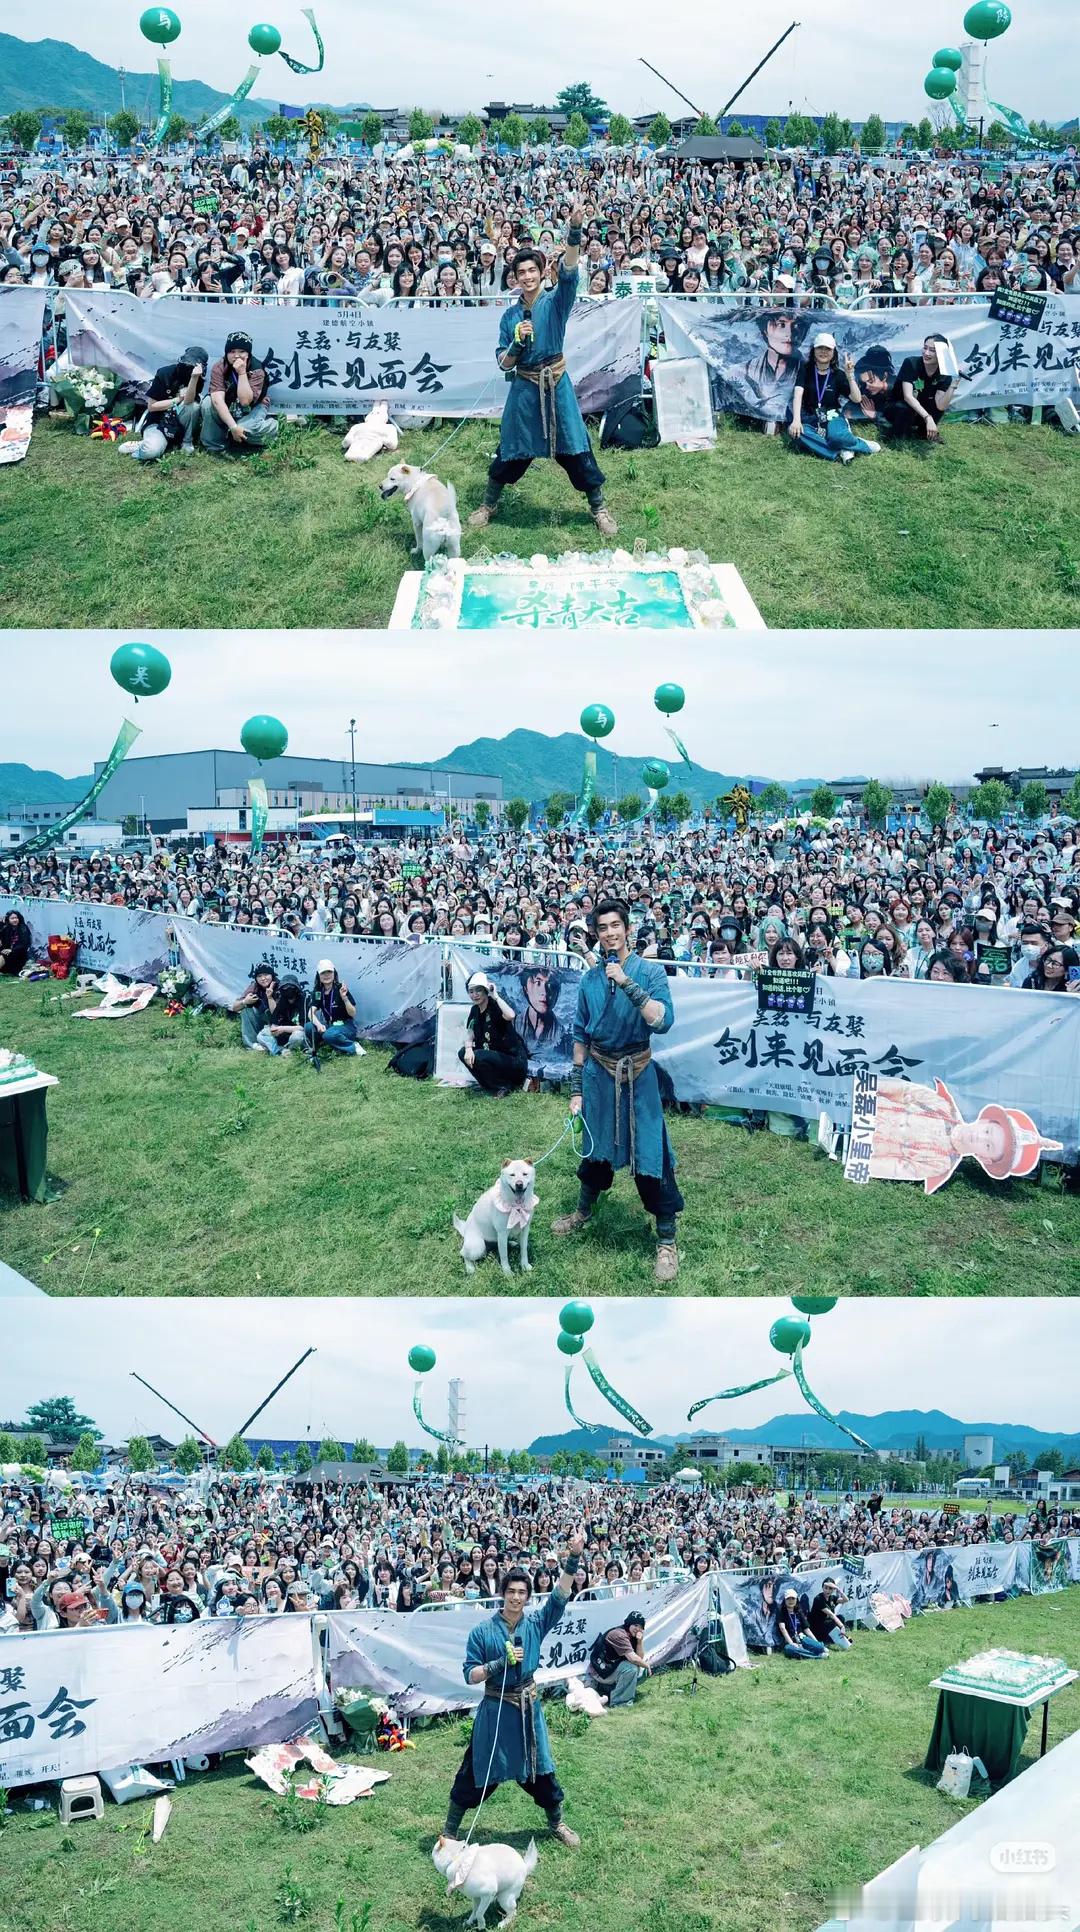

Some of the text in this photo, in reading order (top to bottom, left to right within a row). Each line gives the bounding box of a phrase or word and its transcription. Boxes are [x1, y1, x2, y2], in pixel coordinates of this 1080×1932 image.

[337, 310, 362, 319] 5月4日
[263, 347, 453, 394] 剑来见面会
[714, 1027, 925, 1081] 剑来见面会
[846, 1069, 878, 1183] 吴磊小皇帝
